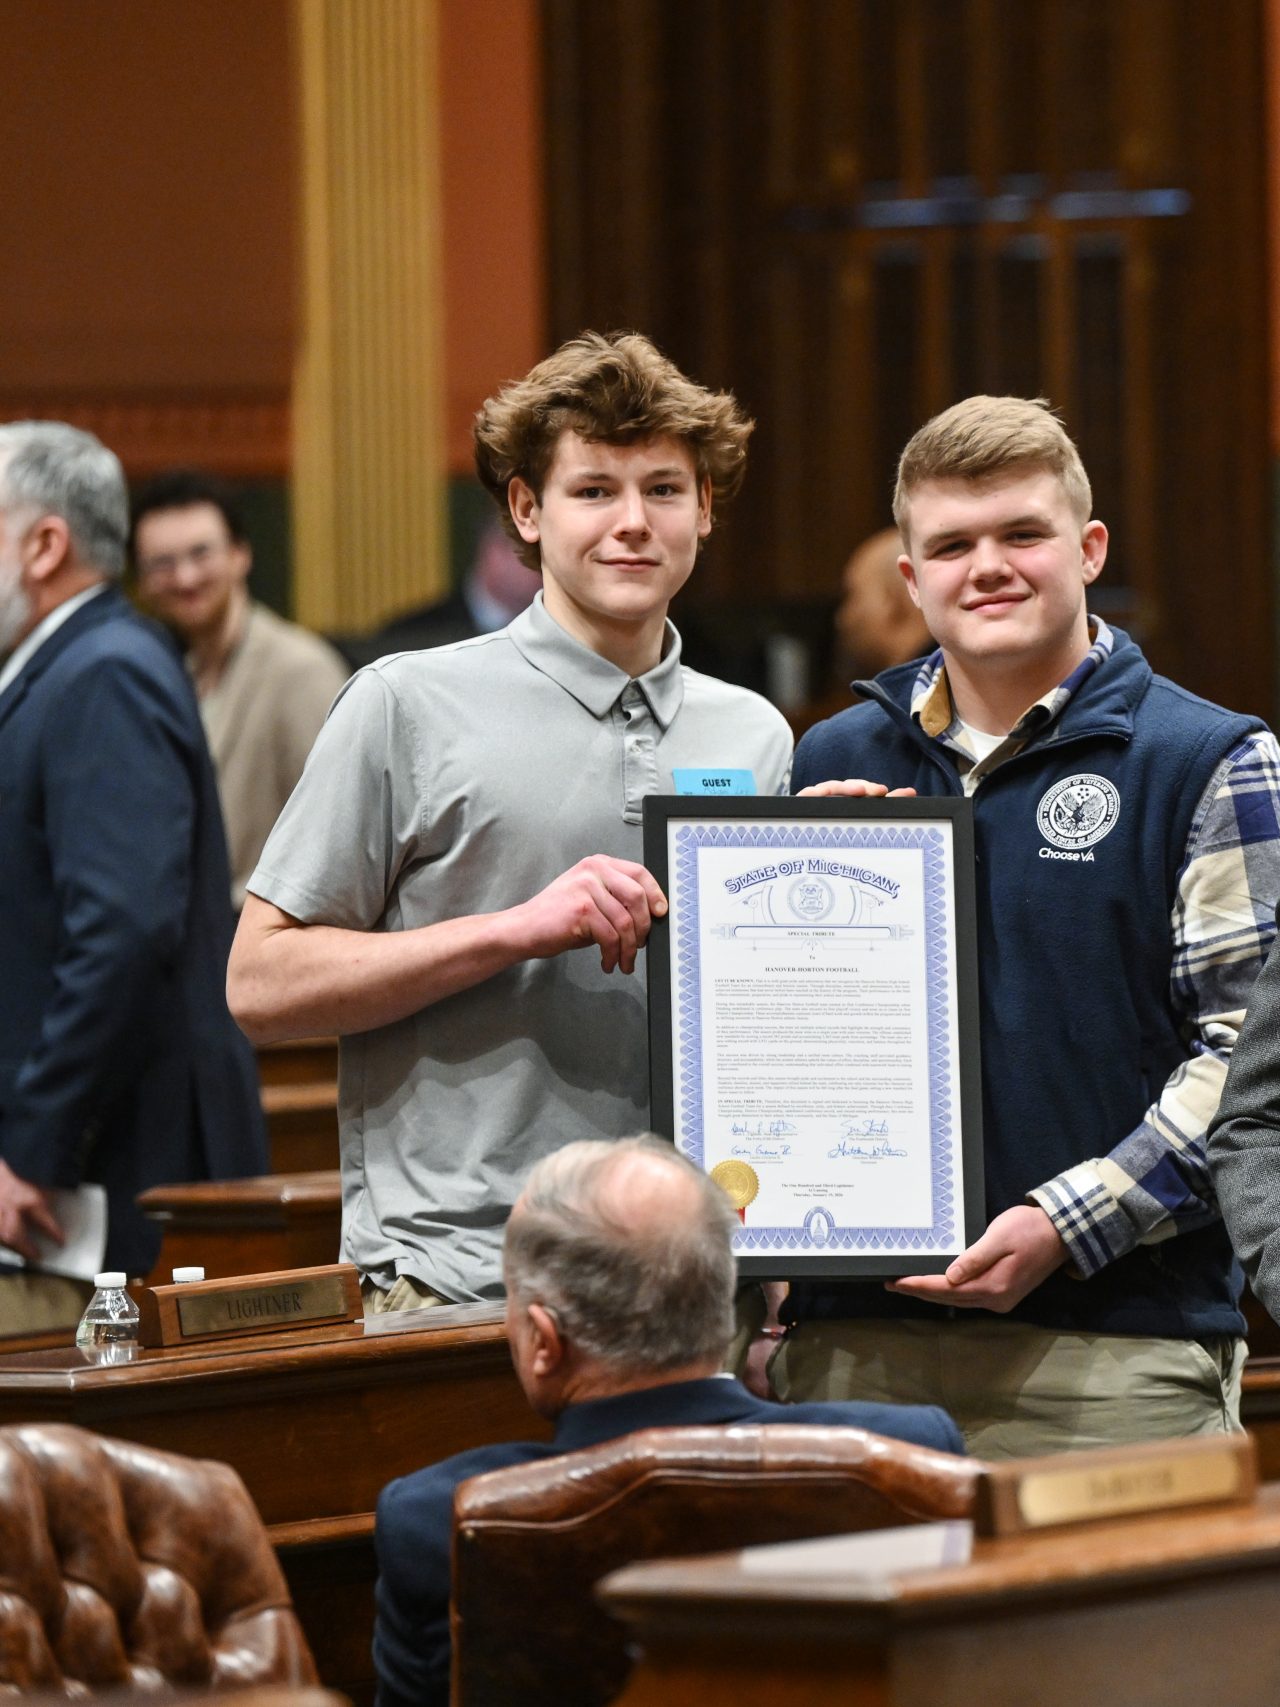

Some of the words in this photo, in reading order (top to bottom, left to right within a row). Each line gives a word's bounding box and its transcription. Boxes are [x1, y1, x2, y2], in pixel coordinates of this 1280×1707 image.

[702, 778, 732, 787] GUEST
[1039, 847, 1080, 861] Choose
[725, 866, 778, 894] STATE
[779, 860, 805, 877] OF
[226, 1292, 302, 1320] LIGHTNER
